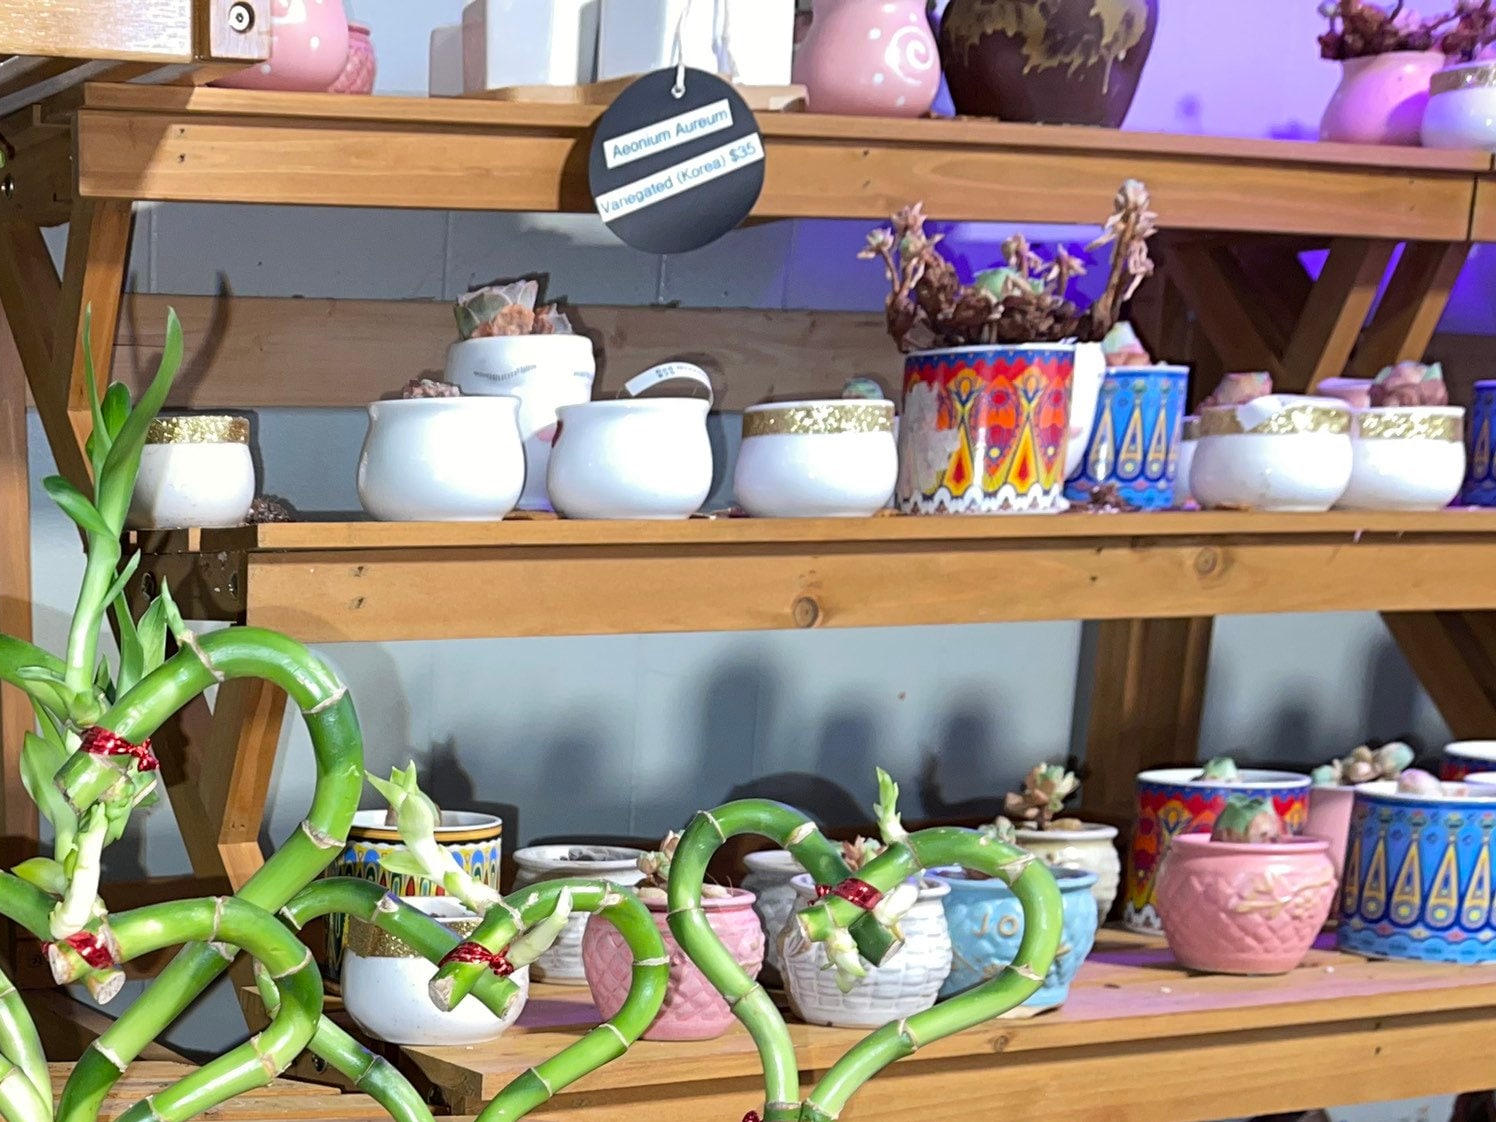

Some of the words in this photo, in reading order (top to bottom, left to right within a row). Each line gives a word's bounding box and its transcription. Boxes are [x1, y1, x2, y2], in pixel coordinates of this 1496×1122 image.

[612, 129, 672, 160] Aeonium
[675, 108, 728, 138] Aureum
[676, 155, 727, 186] (Korea)
[728, 141, 757, 163] $35
